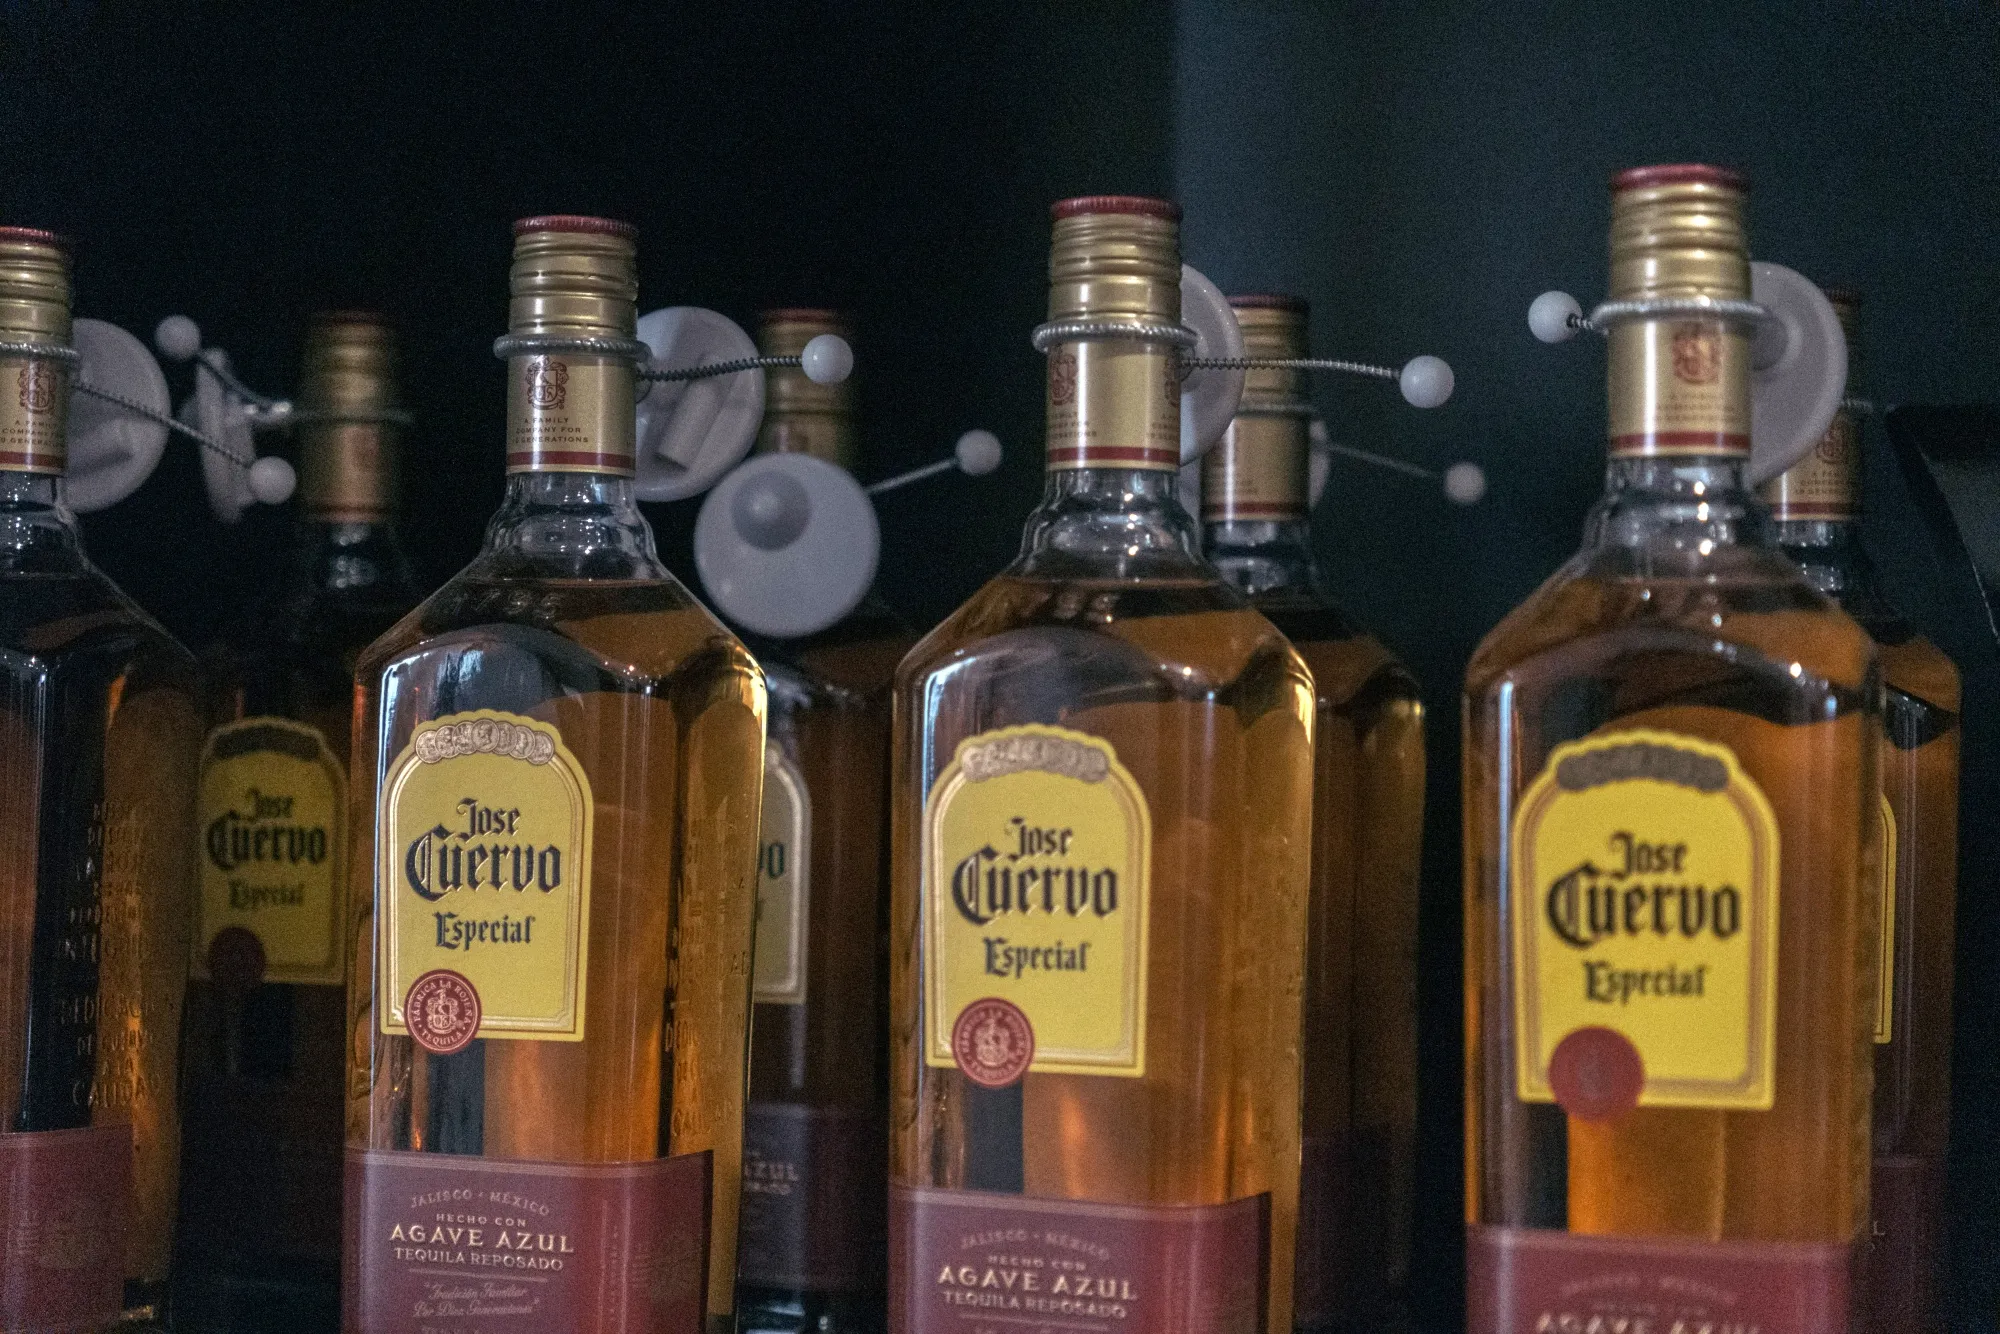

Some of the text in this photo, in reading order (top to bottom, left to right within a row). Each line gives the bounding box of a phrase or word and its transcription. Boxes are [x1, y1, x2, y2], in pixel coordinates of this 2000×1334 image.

[206, 810, 327, 871] Cuervo
[456, 797, 522, 842] Jose
[1006, 816, 1073, 862] Jose
[405, 824, 562, 902] Cuervo
[1607, 830, 1688, 881] Jose
[951, 844, 1119, 926] Cuervo
[1545, 860, 1742, 950] Cuervo
[432, 911, 536, 951] Especial
[982, 936, 1091, 980] Especial
[1582, 959, 1712, 1007] Especial
[421, 1028, 463, 1046] TEQUILA
[410, 1188, 473, 1209] JALISCO
[436, 1213, 527, 1228] HECHO CON
[389, 1224, 575, 1254] AGAVE AZUL
[393, 1247, 564, 1272] TEQUILA REPOSADO
[937, 1266, 1139, 1301] AGAVE AZUL
[942, 1290, 1020, 1312] TEQUILA
